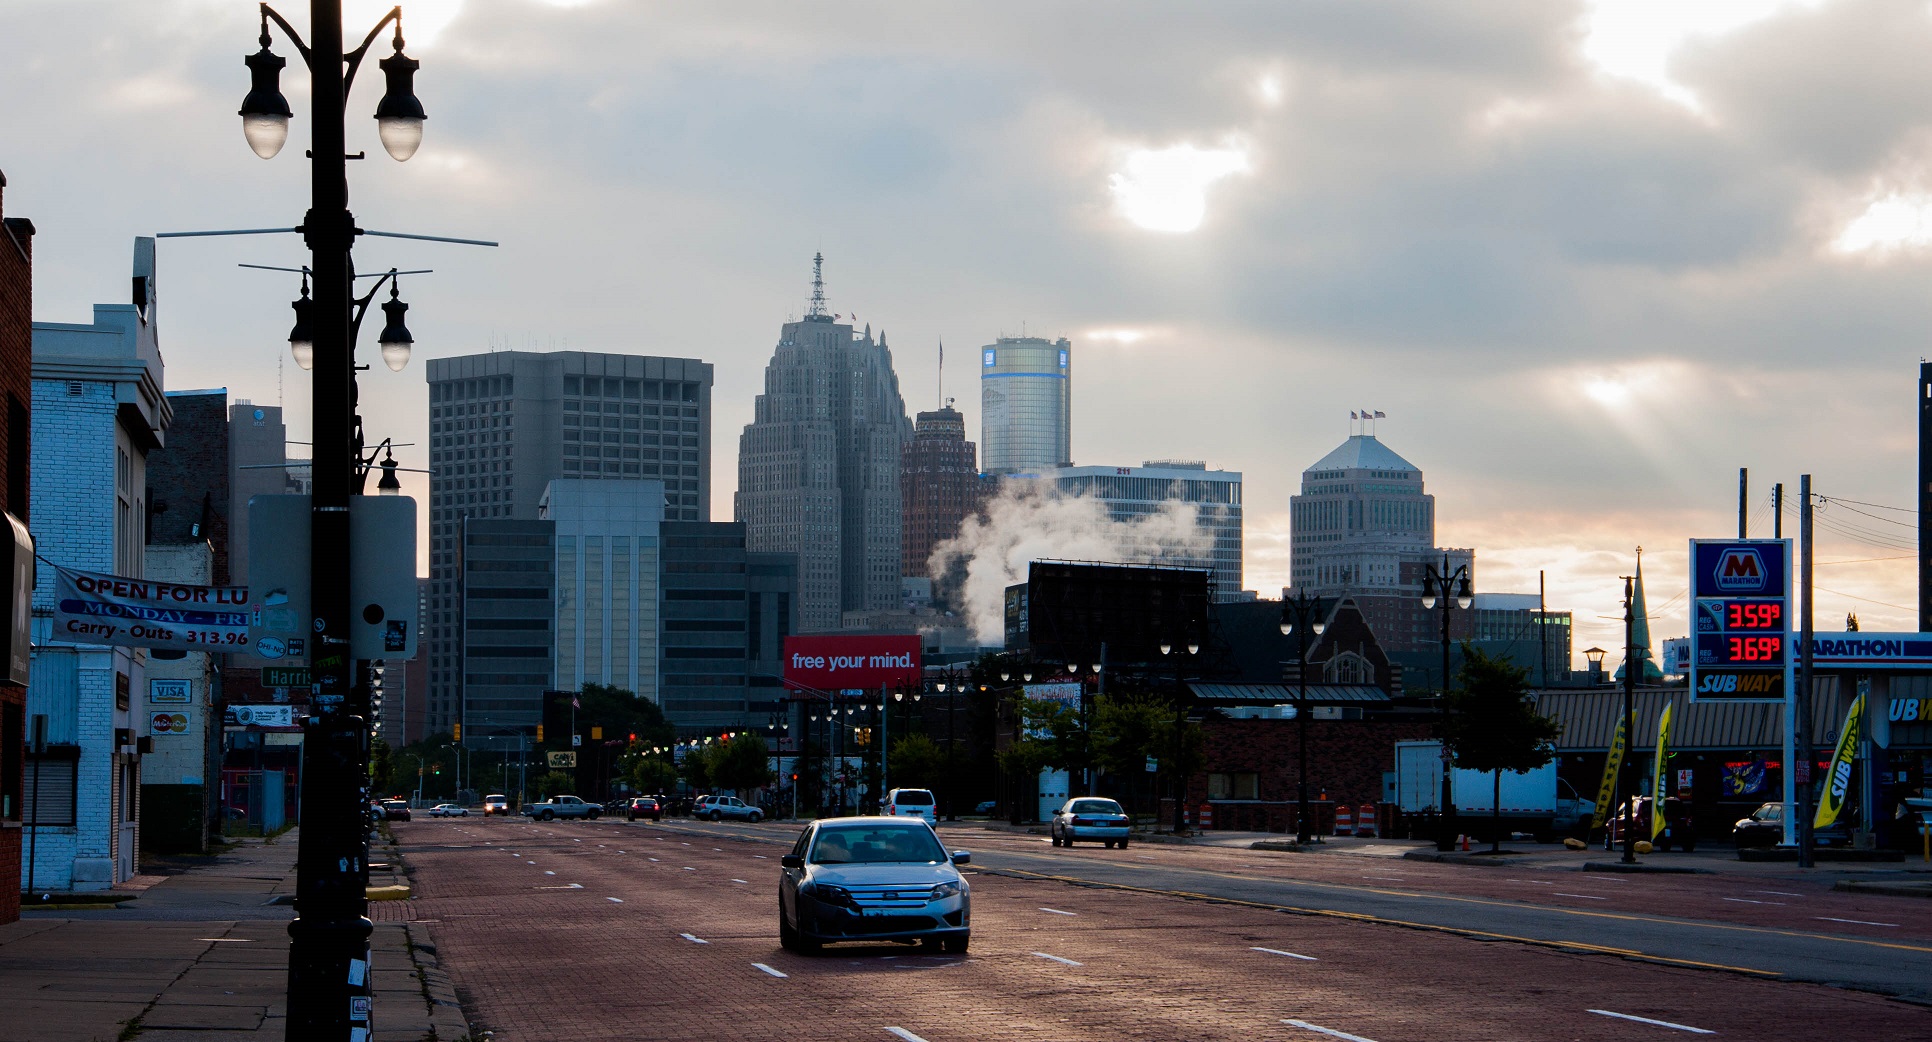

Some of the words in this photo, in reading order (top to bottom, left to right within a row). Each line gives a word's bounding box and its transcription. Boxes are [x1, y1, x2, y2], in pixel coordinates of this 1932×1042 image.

[76, 576, 148, 600] OPEN
[156, 585, 209, 603] FOR
[216, 590, 248, 605] LU
[83, 602, 188, 622] MONDAY
[66, 620, 117, 639] Carry
[130, 625, 173, 640] Outs
[186, 631, 248, 645] 313.96
[792, 653, 825, 669] free
[829, 656, 866, 672] your
[869, 652, 915, 668] mind.
[156, 686, 186, 697] VISA
[1697, 674, 1783, 693] SUBWAY
[1831, 717, 1858, 805] SUBWAY
